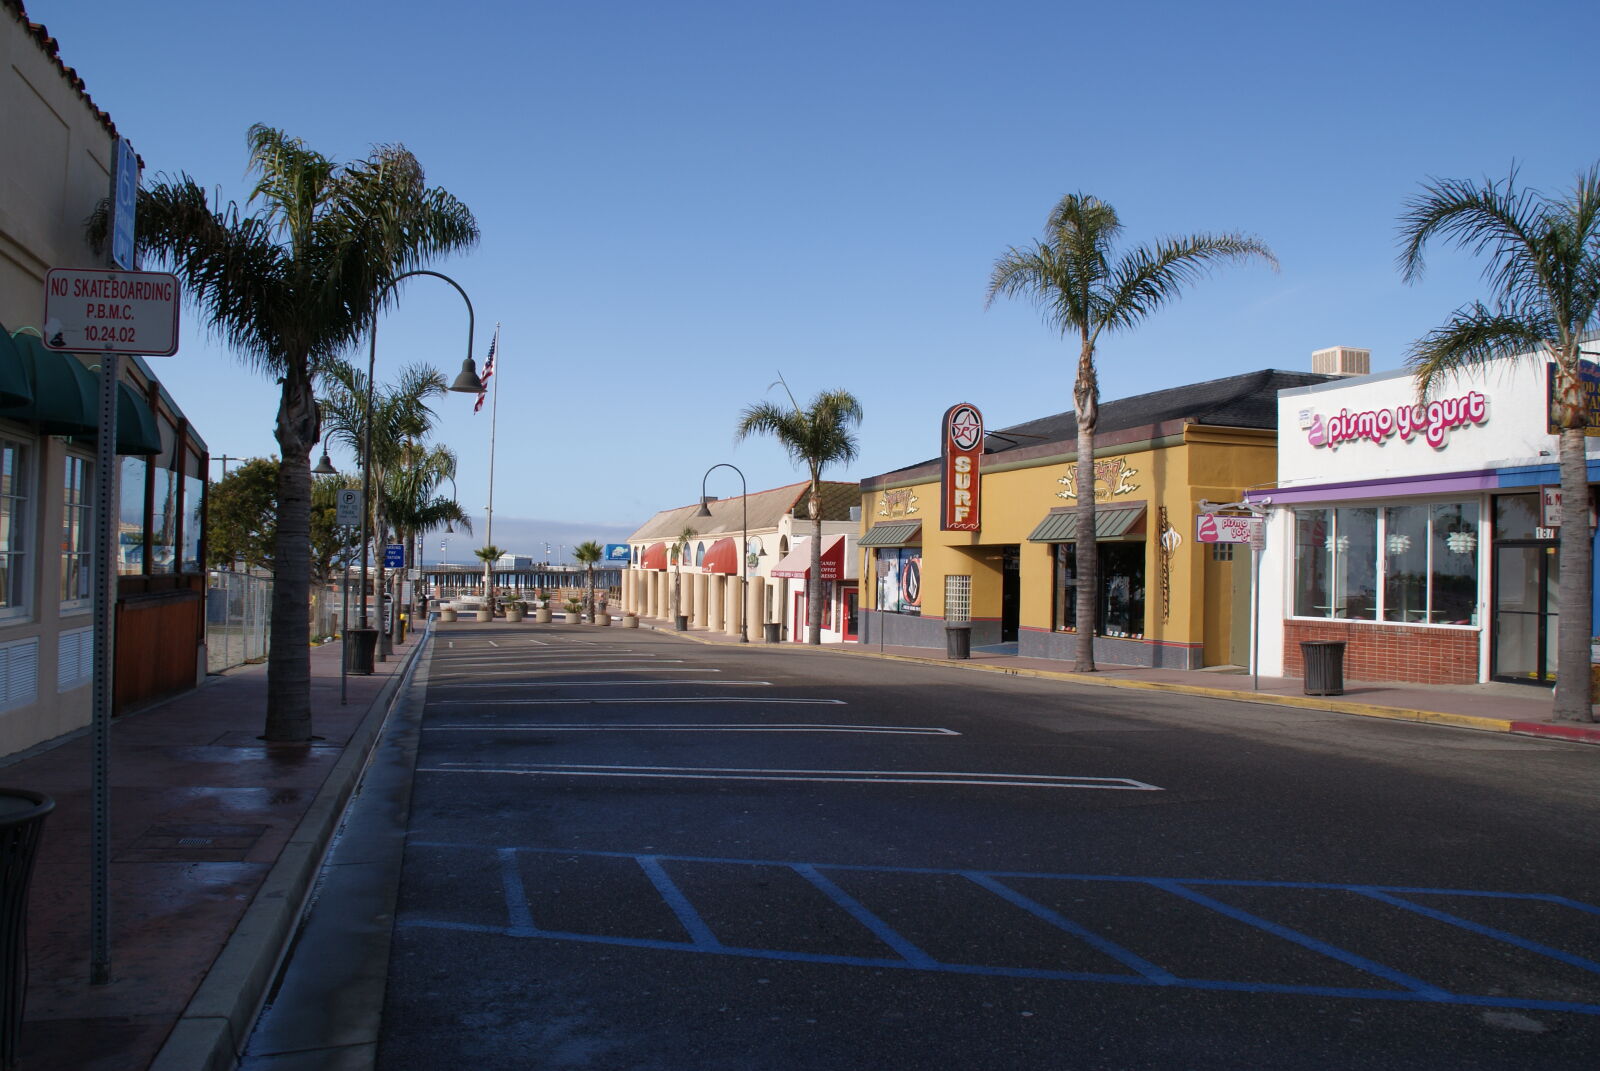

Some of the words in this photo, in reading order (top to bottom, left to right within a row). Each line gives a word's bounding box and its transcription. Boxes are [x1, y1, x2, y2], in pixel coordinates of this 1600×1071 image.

[51, 278, 68, 297] NO
[74, 279, 172, 302] SKATEBOARDING
[86, 303, 135, 320] P.B.M.C.
[84, 325, 135, 343] 10.24.02
[1327, 408, 1394, 449] pismo
[1397, 391, 1486, 448] yogurt
[954, 456, 972, 522] SURF
[1222, 519, 1248, 530] pismo
